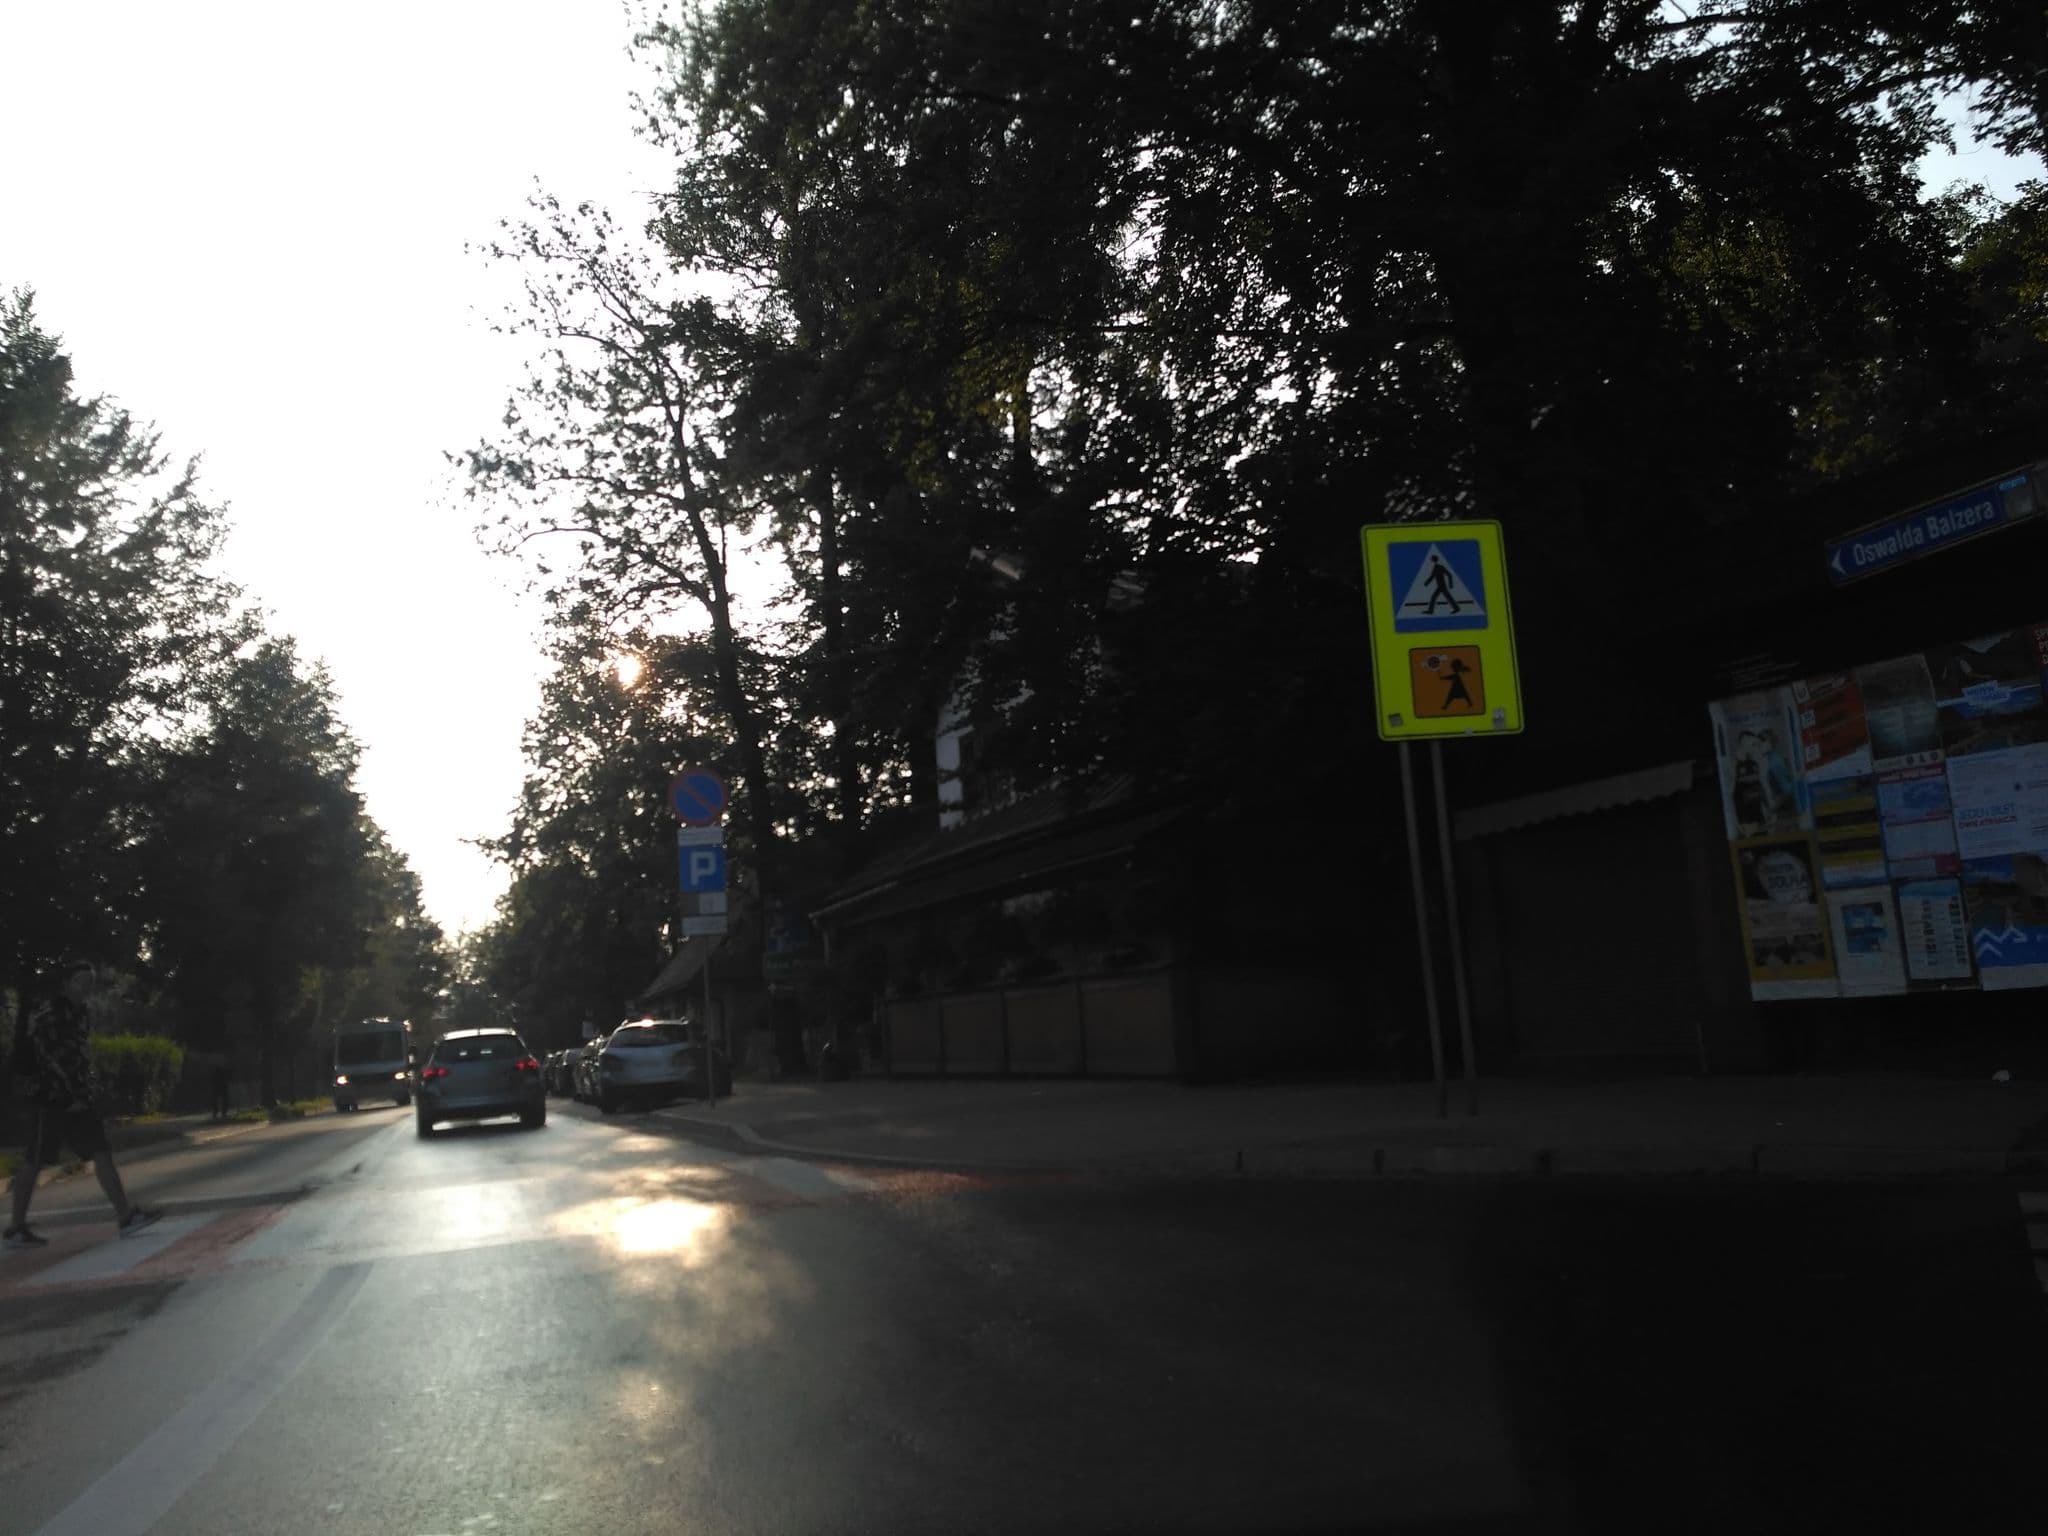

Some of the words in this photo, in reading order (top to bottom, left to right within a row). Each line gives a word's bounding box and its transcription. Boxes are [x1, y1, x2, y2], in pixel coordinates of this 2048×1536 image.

[1852, 523, 1924, 566] Oswalda
[1925, 501, 1995, 540] Balzera
[689, 851, 717, 886] P
